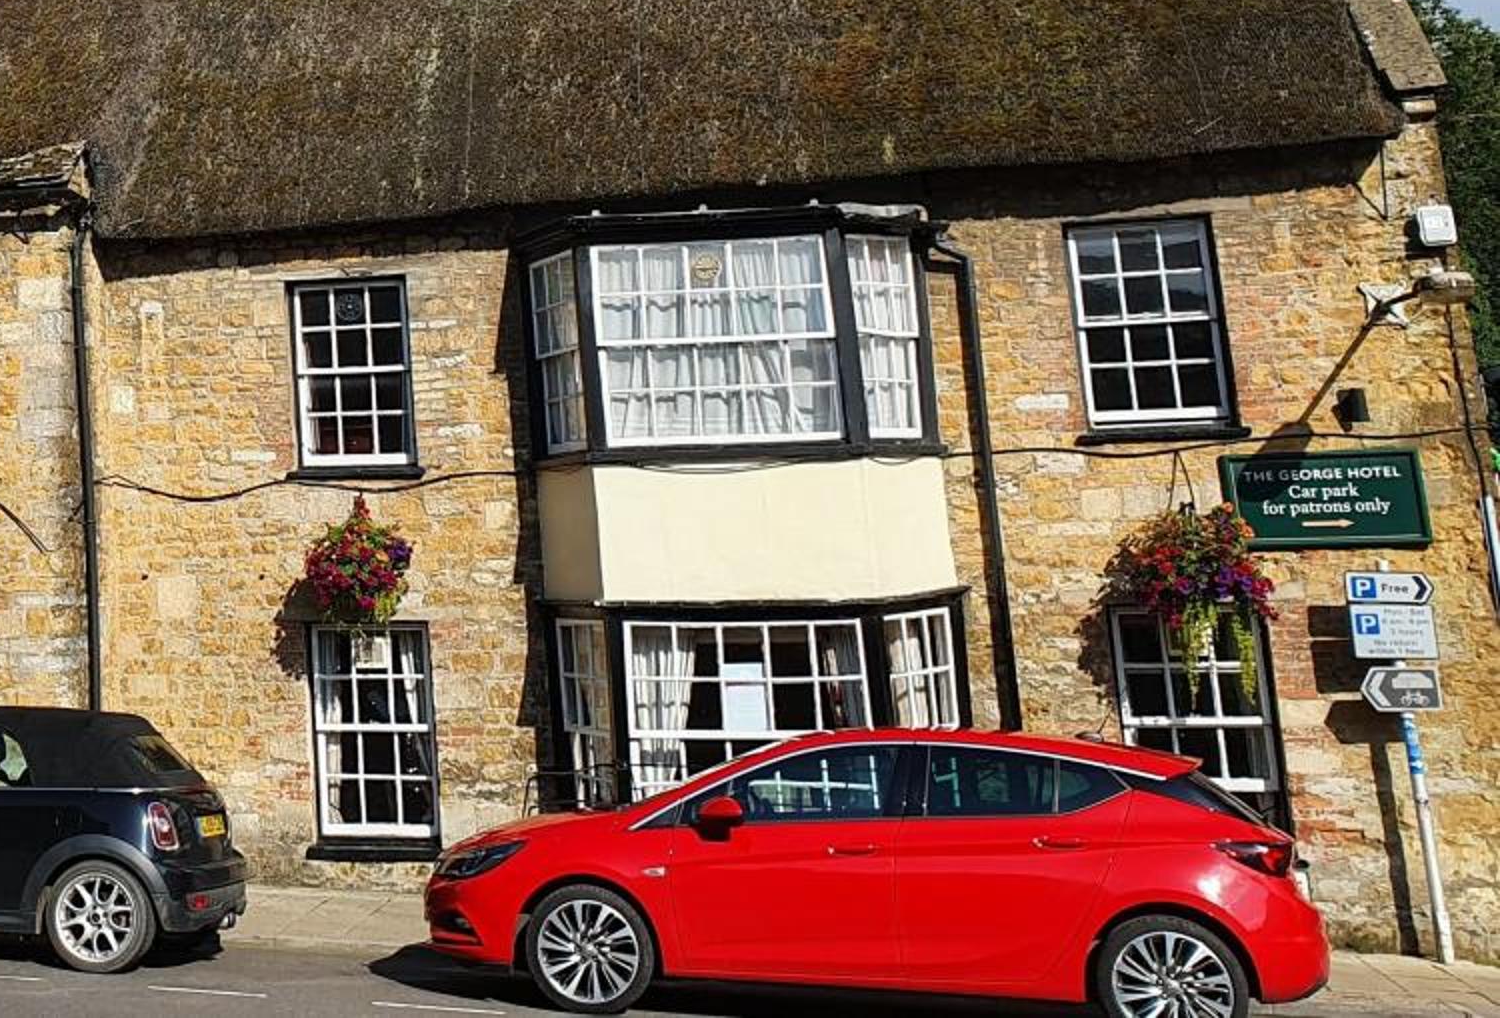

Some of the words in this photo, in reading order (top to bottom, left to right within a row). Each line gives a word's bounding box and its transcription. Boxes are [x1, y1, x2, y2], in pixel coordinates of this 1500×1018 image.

[1243, 470, 1273, 482] THE
[1279, 467, 1343, 481] GEORGE
[1347, 466, 1402, 479] HOTEL
[1288, 485, 1316, 499] Car
[1322, 482, 1360, 500] park
[1262, 500, 1287, 515] for
[1290, 500, 1351, 518] patrons
[1355, 498, 1391, 514] only
[1355, 579, 1371, 597] P
[1381, 583, 1409, 594] Free
[1361, 615, 1377, 634] P
